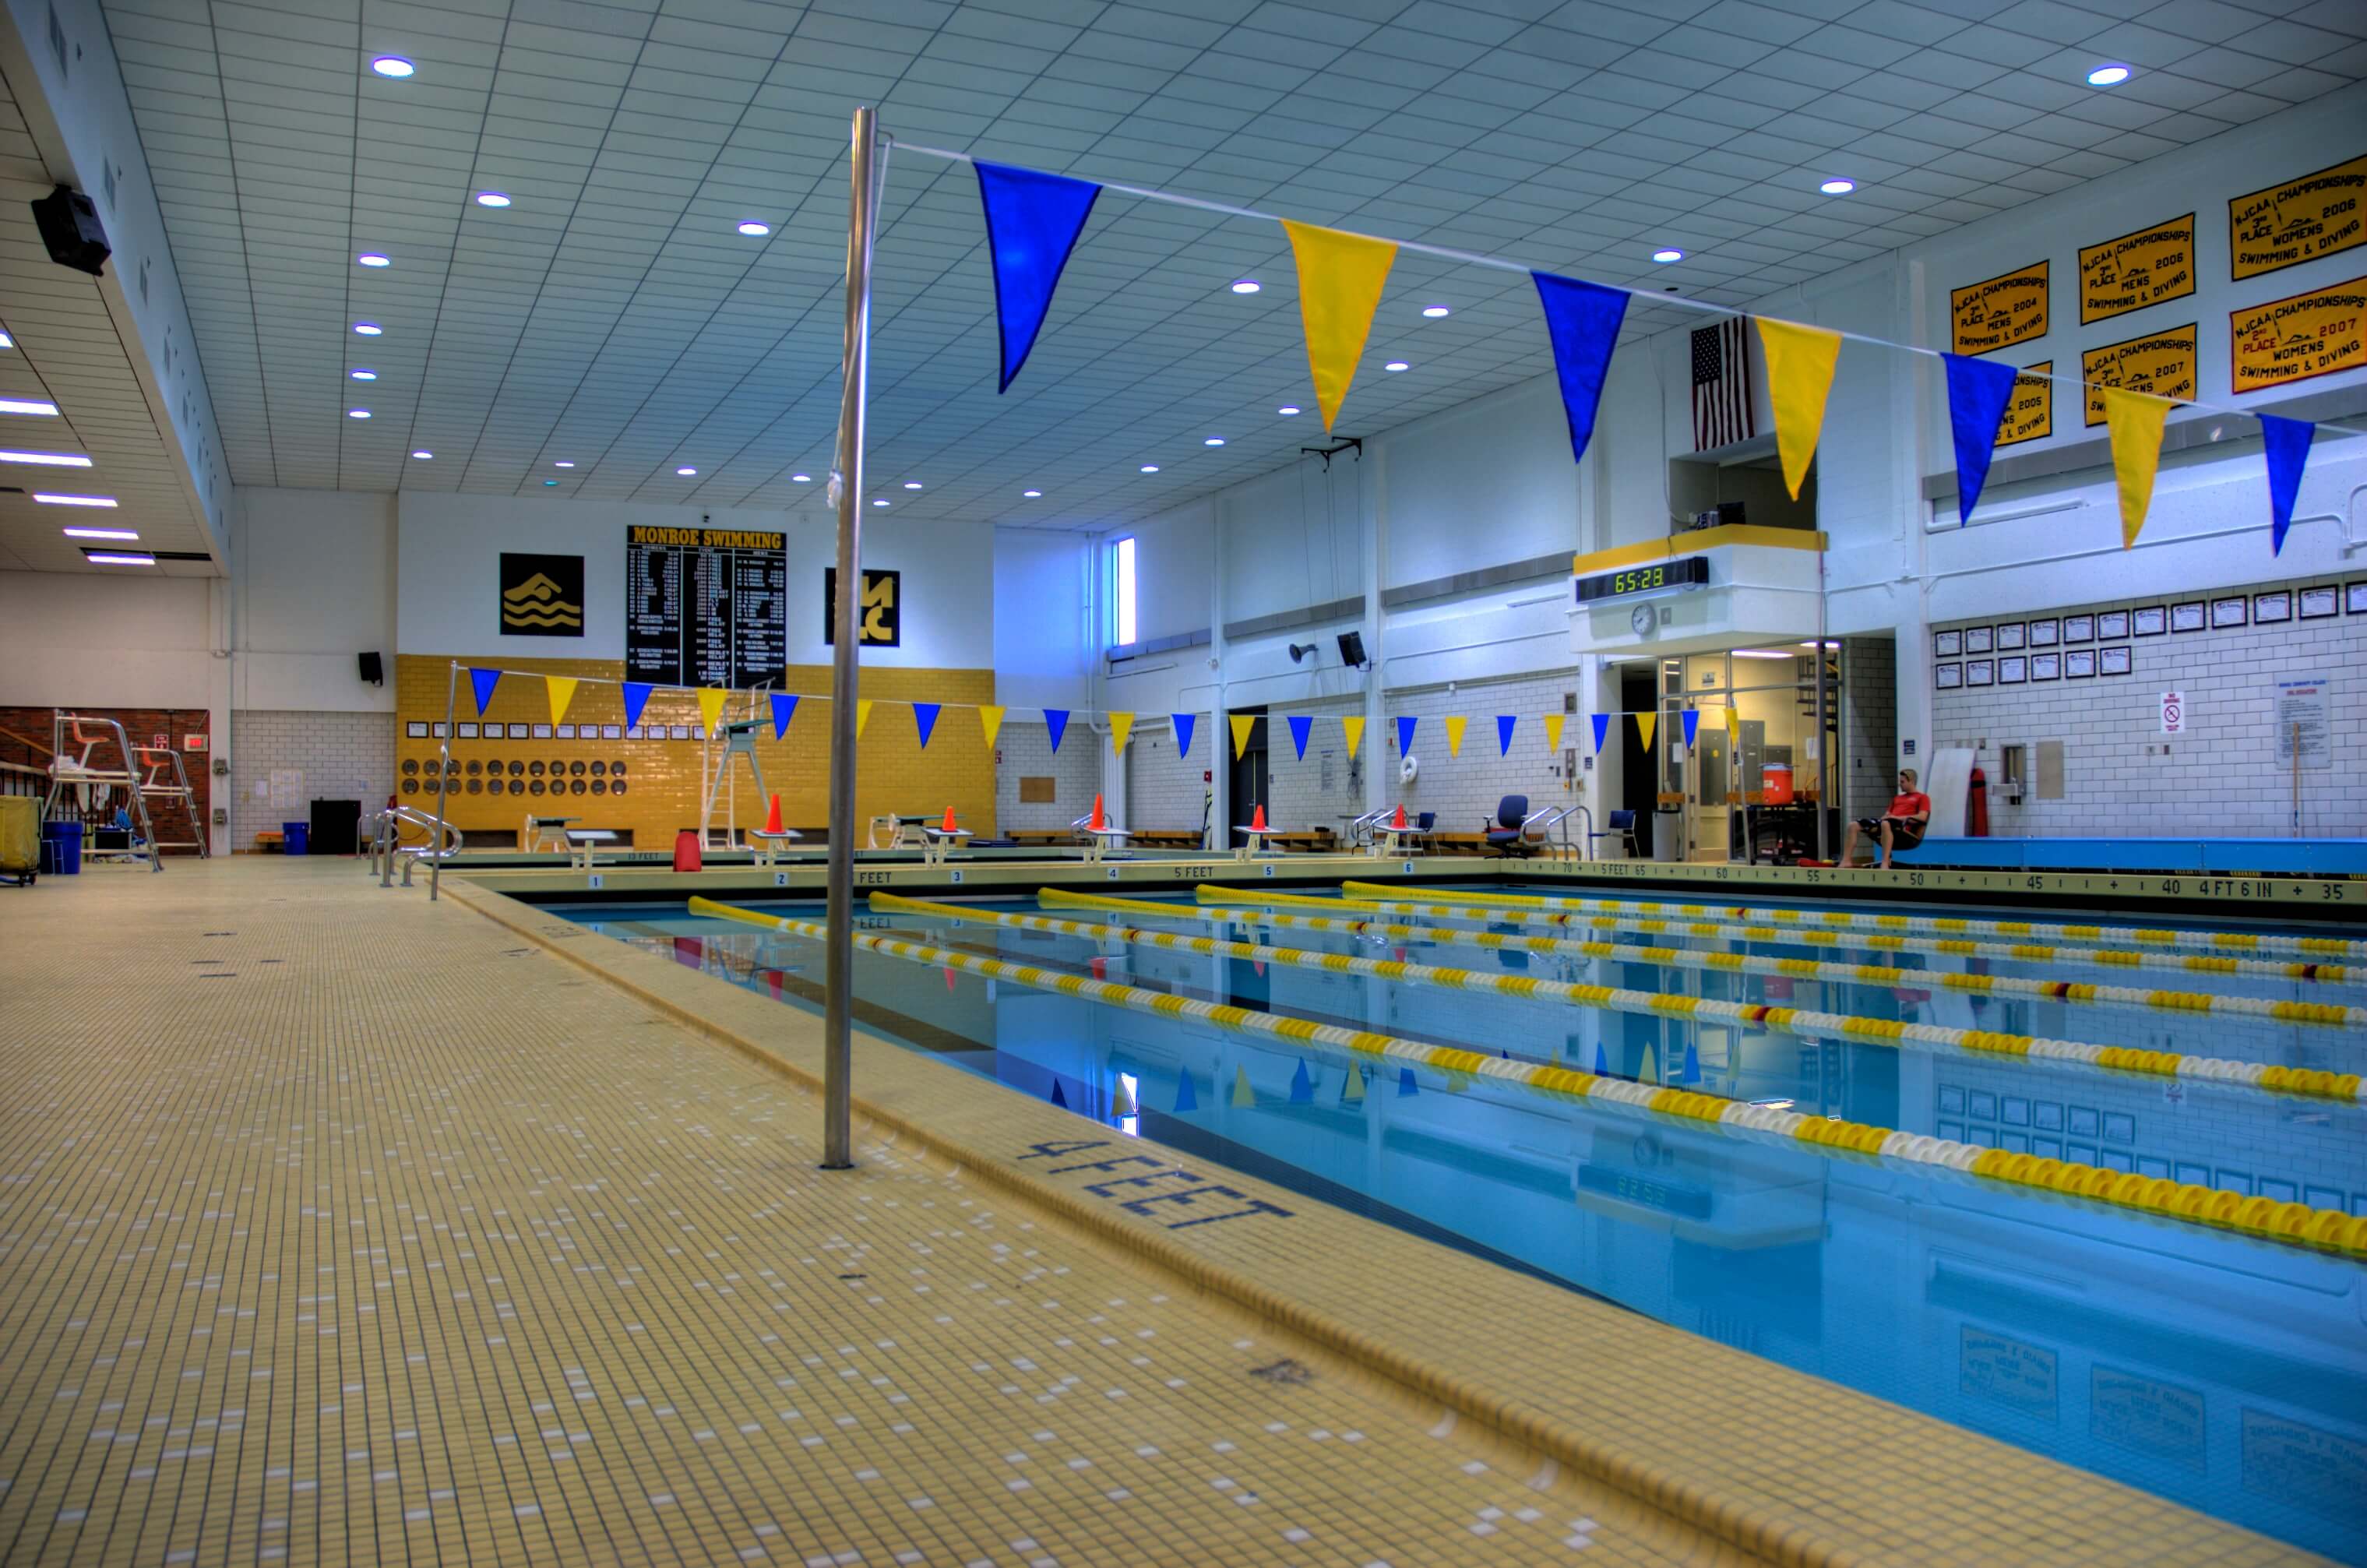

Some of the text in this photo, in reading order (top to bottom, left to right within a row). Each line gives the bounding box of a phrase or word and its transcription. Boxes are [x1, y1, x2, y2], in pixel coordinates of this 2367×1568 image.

[2235, 174, 2366, 226] NJCAA CHAMPIONSHIPS
[2238, 248, 2298, 264] SWIMMING
[2319, 219, 2360, 250] DIVING
[2240, 224, 2273, 243] PLACE
[2273, 223, 2323, 247] WOMENS
[2083, 230, 2190, 273] NJCAA CHAMPIONSHIPS
[1982, 277, 2045, 297] CHAMPIONSHIPS
[2087, 294, 2136, 309] SWIMMING
[2153, 270, 2187, 297] DIVING
[2089, 273, 2116, 290] PLACE
[2121, 276, 2150, 292] MENS
[1961, 313, 1984, 328] PLACE
[1988, 317, 2011, 331] MENS
[2235, 295, 2366, 339] NJCAA CHAMPIONSHIPS
[1959, 334, 1999, 347] SWIMMING
[2013, 313, 2042, 337] DIVING
[2319, 318, 2357, 337] 2007
[2243, 337, 2277, 354] PLACE
[2273, 340, 2324, 361] WOMENS
[2085, 339, 2193, 377] NJCAA CHAMPIONSHIPS
[2240, 364, 2298, 379] SWIMMING
[2319, 339, 2360, 367] DIVING
[2155, 361, 2184, 378] 2007
[2017, 413, 2045, 435] DIVING
[634, 527, 782, 550] MONROE SWIMMING
[1109, 869, 1116, 878] 4
[1175, 866, 1213, 878] 5 FEET
[1266, 866, 1272, 876] 5
[1564, 863, 1573, 873] 70
[1601, 864, 1628, 875] 5 FEET
[1636, 865, 1645, 876] 65
[1716, 868, 1728, 879] 60
[1807, 869, 1820, 881] 55
[779, 874, 786, 884] 2
[860, 872, 892, 883] FEET
[954, 872, 960, 882] 3
[1911, 873, 1924, 885] 50
[2027, 876, 2043, 890] 45
[2162, 879, 2180, 893] 40
[2200, 881, 2272, 897] 4 FT 6 IN
[2323, 884, 2343, 899] 35
[1048, 1155, 1296, 1230] FEET
